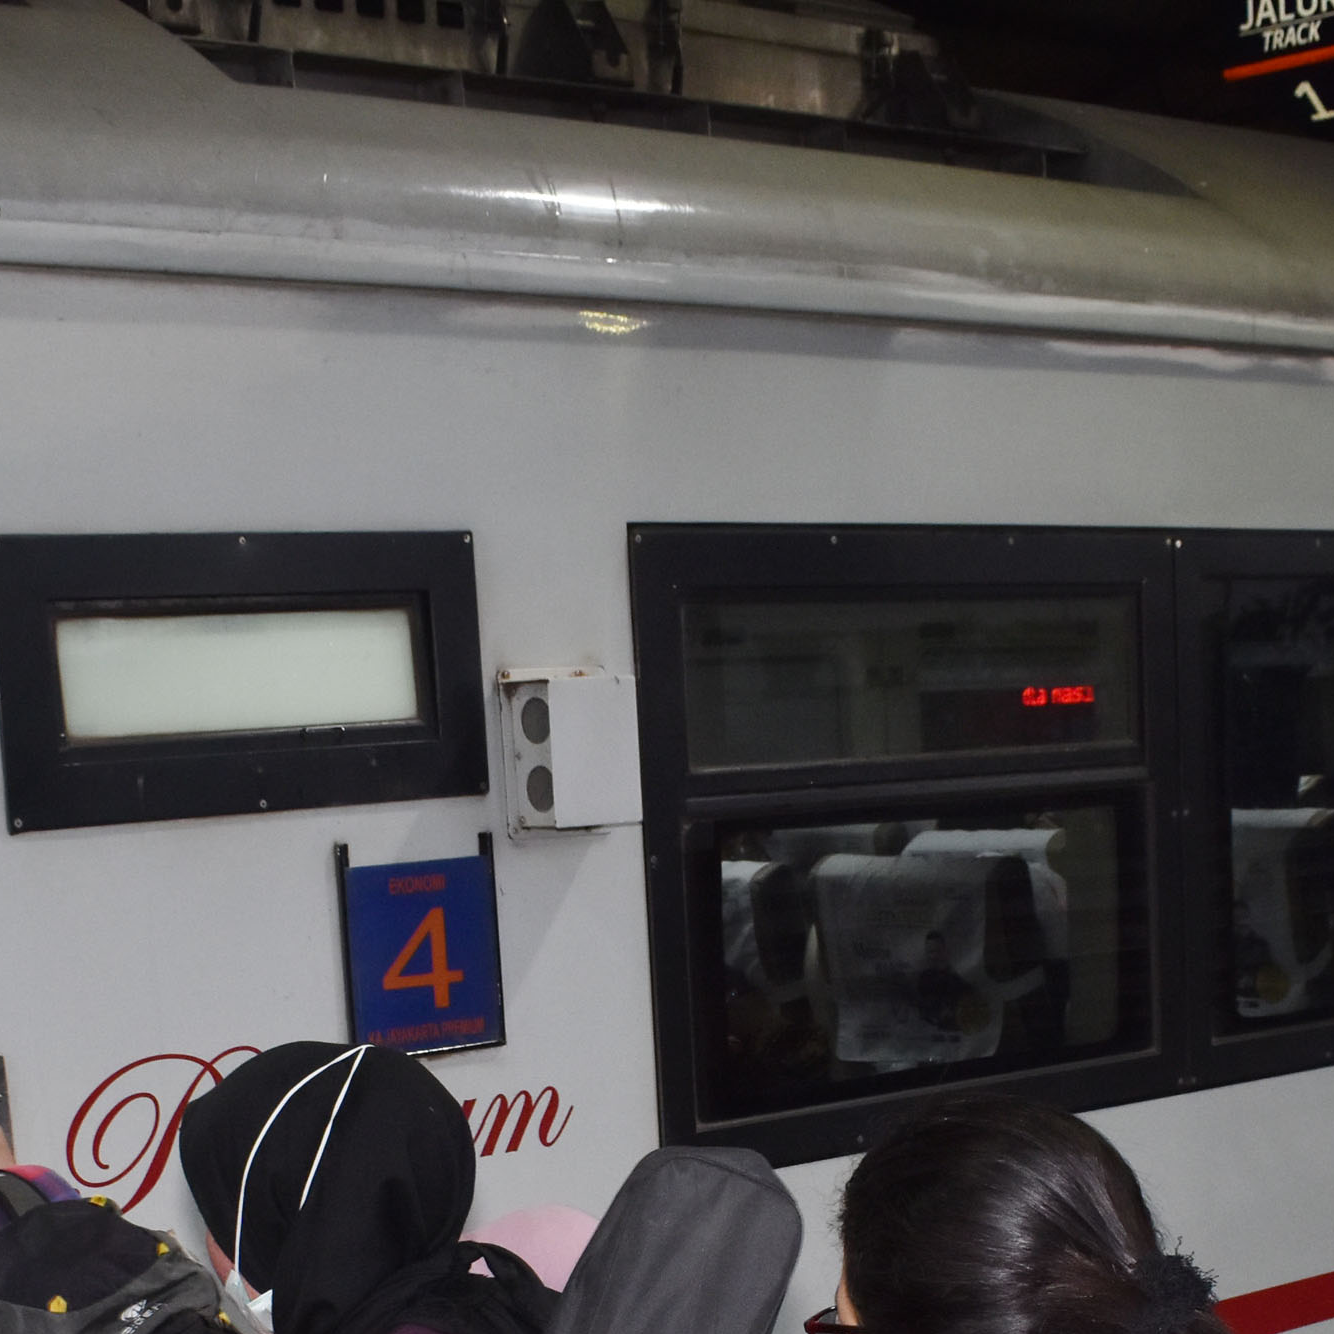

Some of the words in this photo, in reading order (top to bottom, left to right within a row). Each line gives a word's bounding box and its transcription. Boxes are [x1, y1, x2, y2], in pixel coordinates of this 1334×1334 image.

[1263, 20, 1322, 53] TRACK
[389, 874, 446, 896] EKONOMI
[382, 906, 464, 1009] 4
